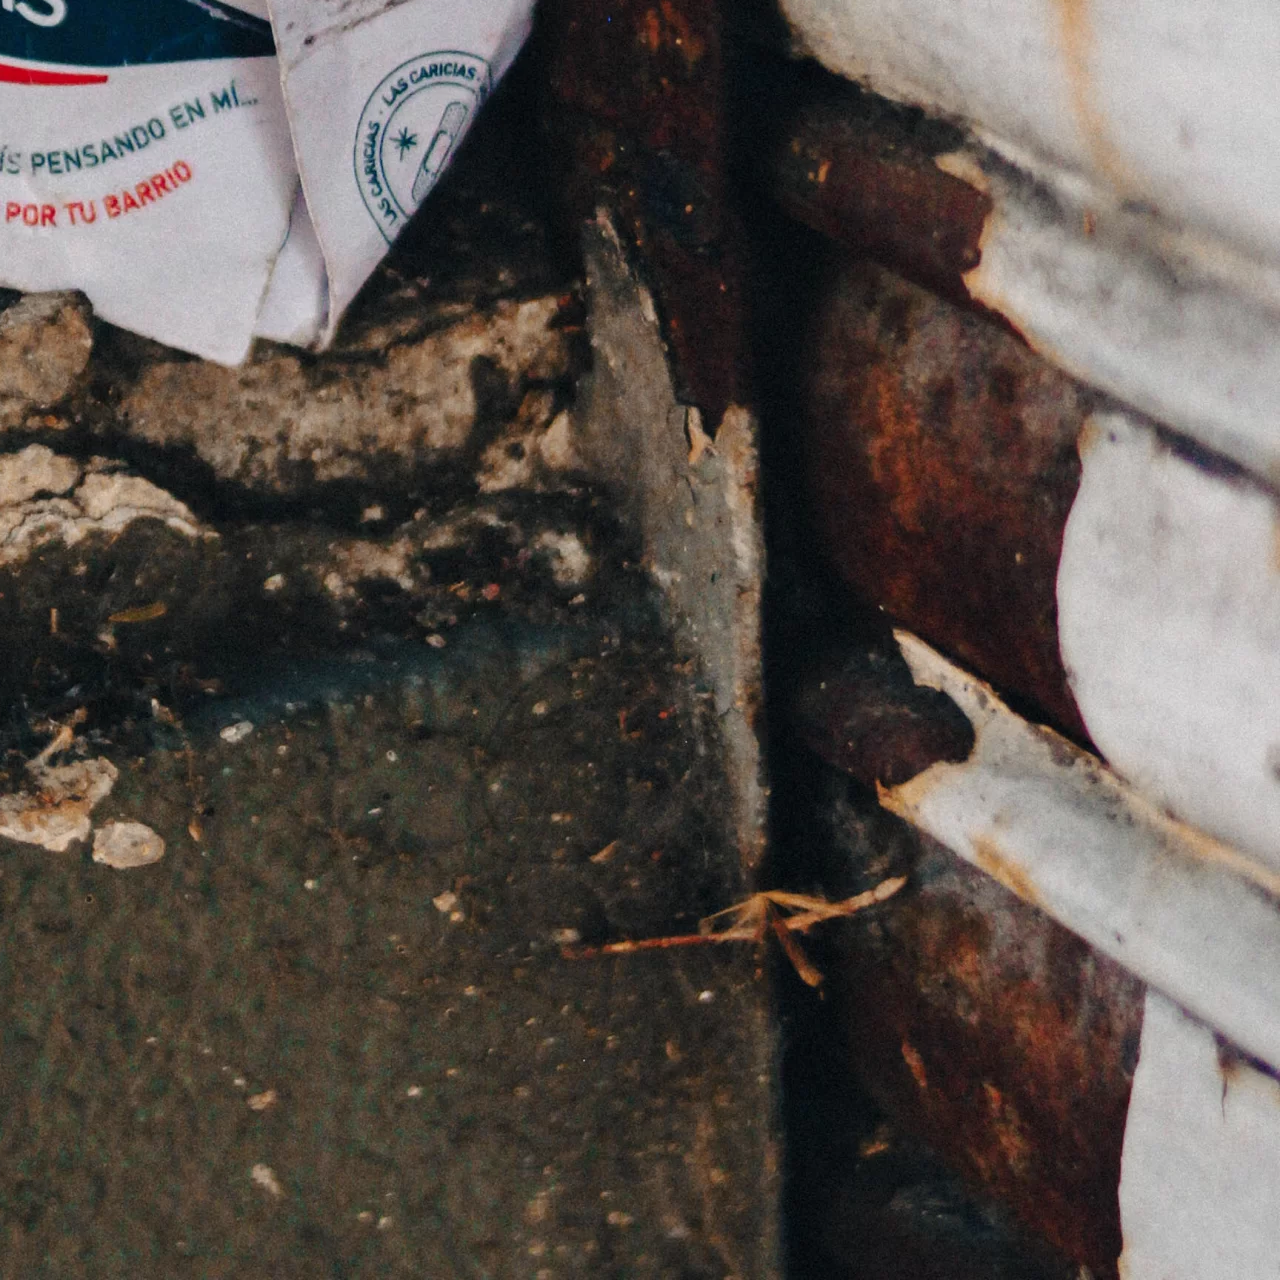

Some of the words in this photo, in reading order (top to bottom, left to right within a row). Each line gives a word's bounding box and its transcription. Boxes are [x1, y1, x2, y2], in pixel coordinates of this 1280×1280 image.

[382, 78, 409, 107] LAS
[409, 62, 479, 85] CARICIAS
[31, 118, 166, 176] PENSANDO
[169, 98, 207, 130] EN
[6, 202, 57, 227] POR
[63, 201, 97, 225] TU
[104, 160, 194, 219] BARRIO
